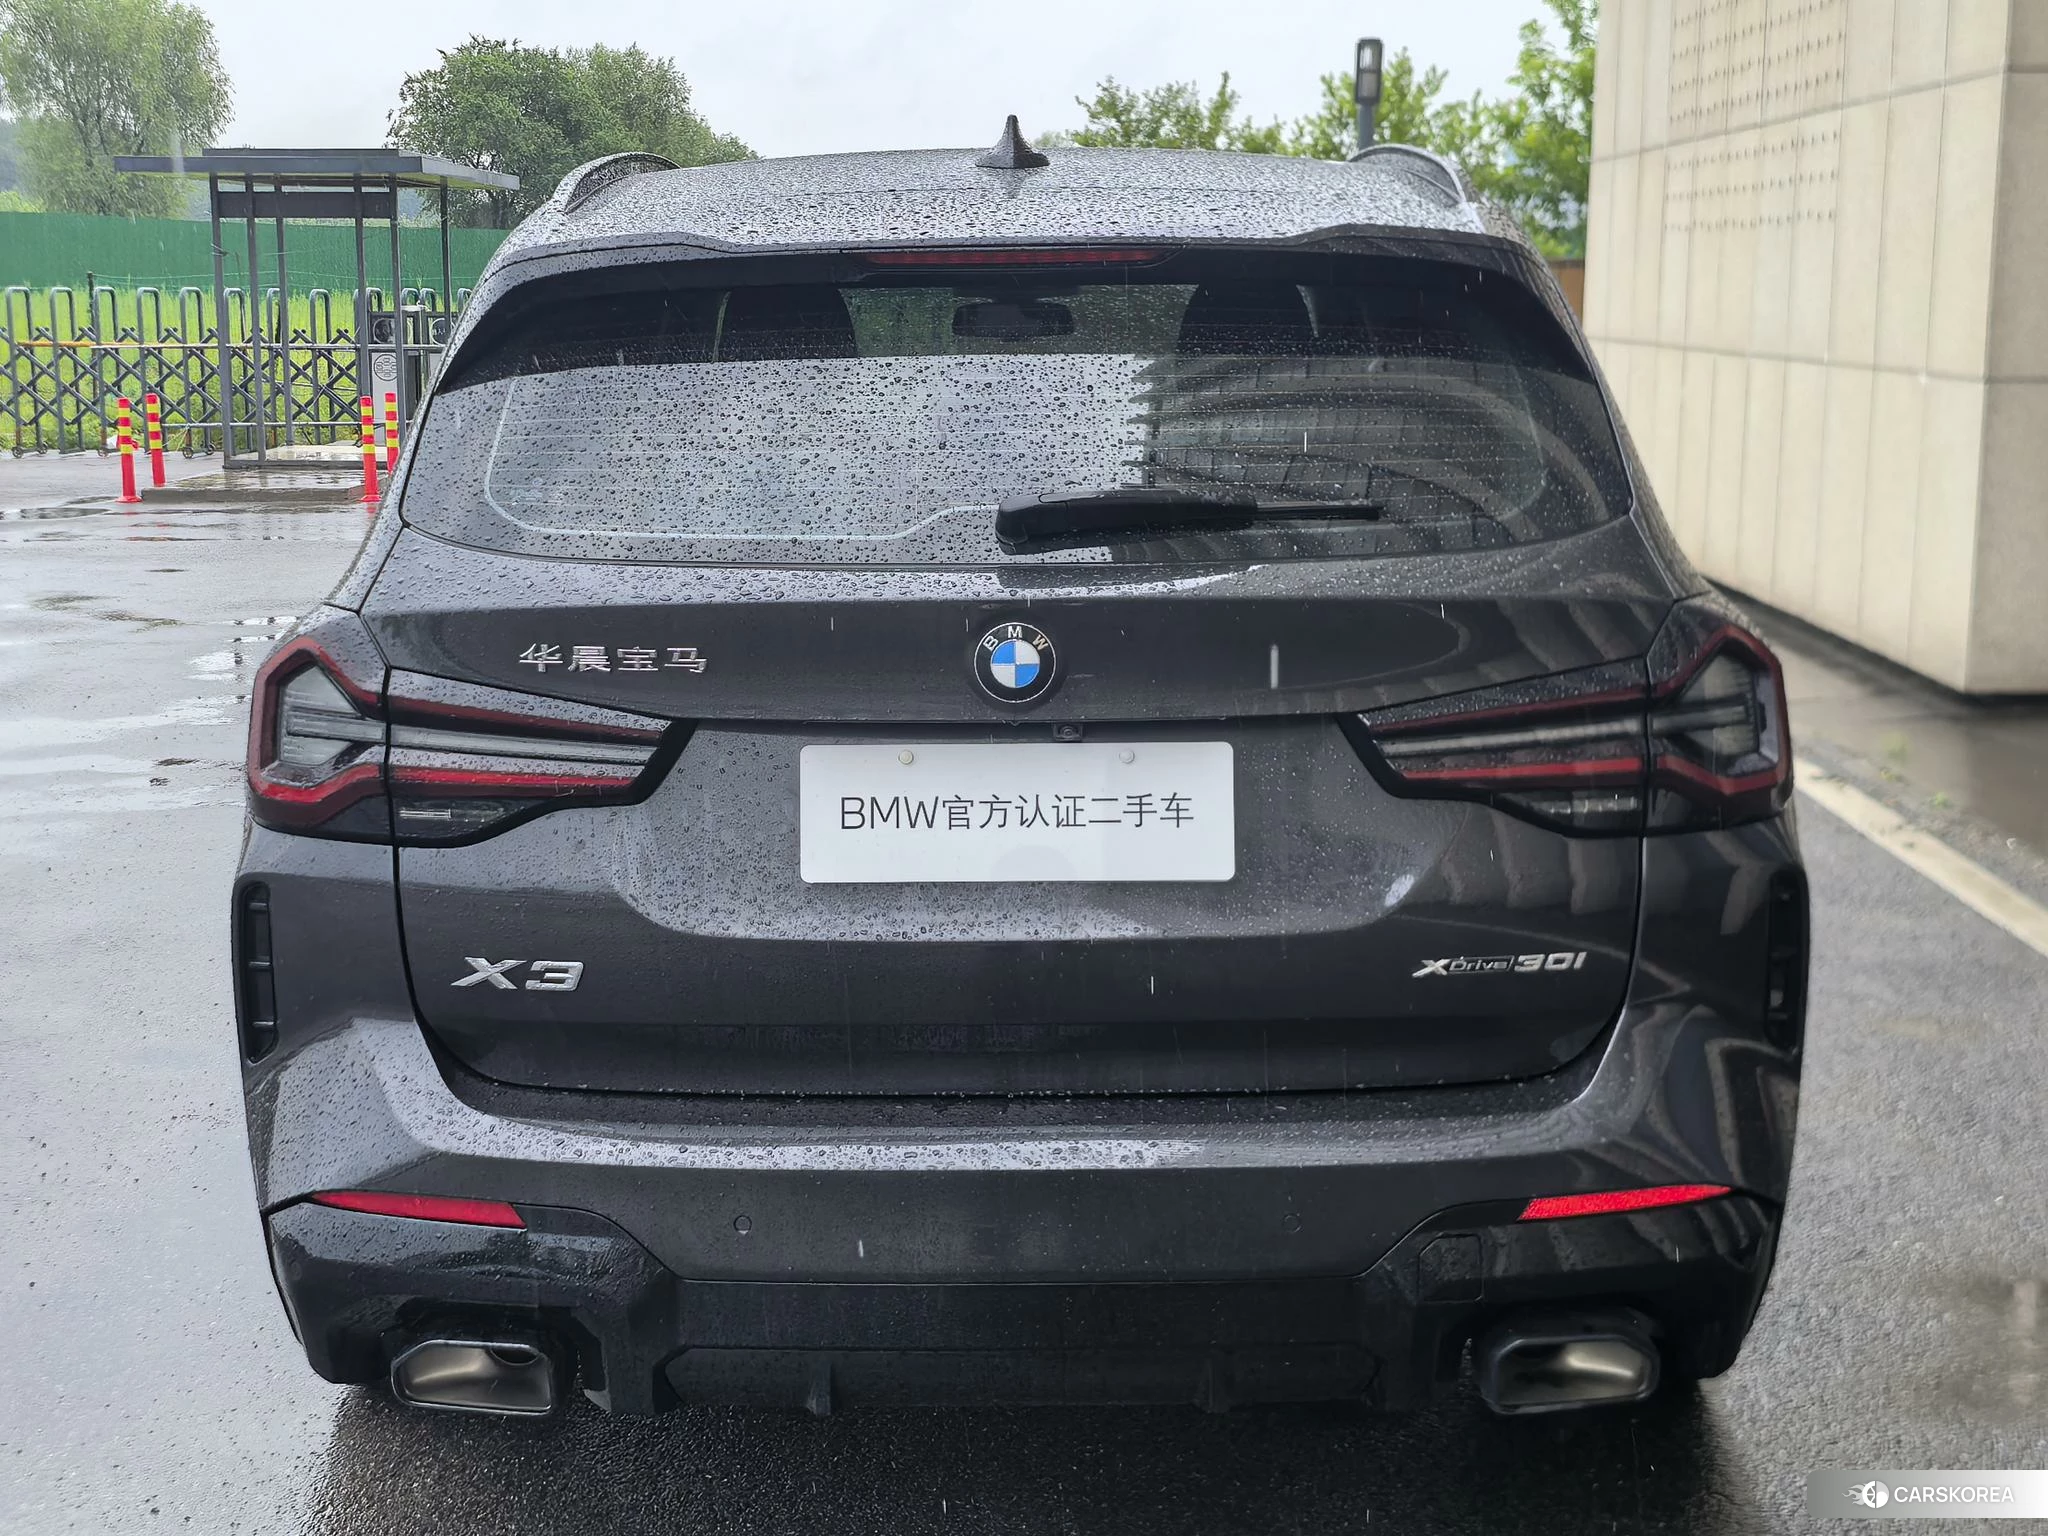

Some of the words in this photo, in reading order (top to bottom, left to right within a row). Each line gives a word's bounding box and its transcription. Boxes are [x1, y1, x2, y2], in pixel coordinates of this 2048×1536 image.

[983, 625, 1049, 652] BMW
[519, 643, 708, 673] 华晨宝马
[840, 792, 1195, 831] BMW官方认证二手车
[450, 956, 585, 992] X3
